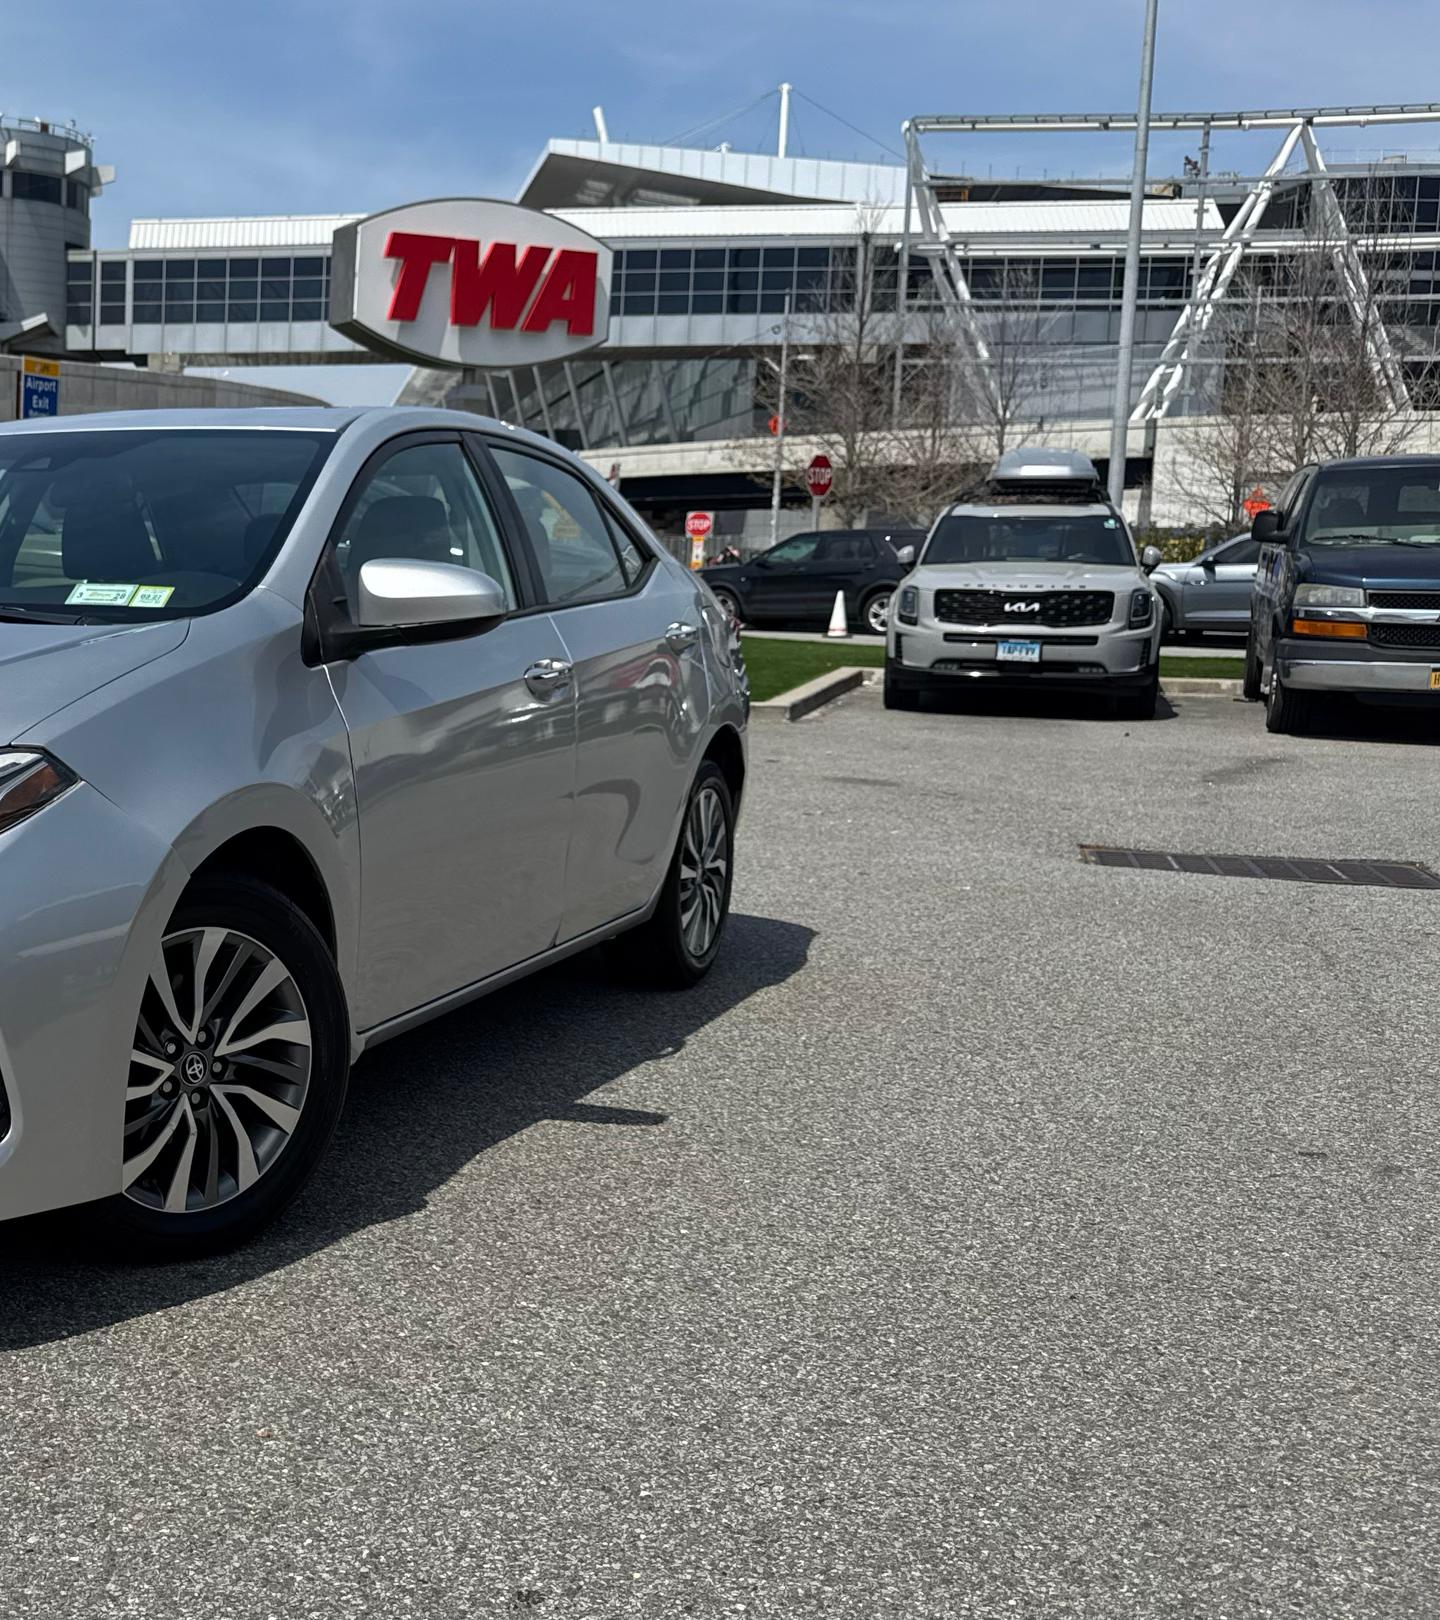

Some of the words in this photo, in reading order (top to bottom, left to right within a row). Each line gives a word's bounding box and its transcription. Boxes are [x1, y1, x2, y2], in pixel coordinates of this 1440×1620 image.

[384, 231, 598, 337] TWA
[26, 376, 57, 393] Airport
[32, 394, 49, 410] Exit
[808, 467, 831, 485] STOP
[687, 519, 711, 531] STOP
[1004, 602, 1040, 612] KIA
